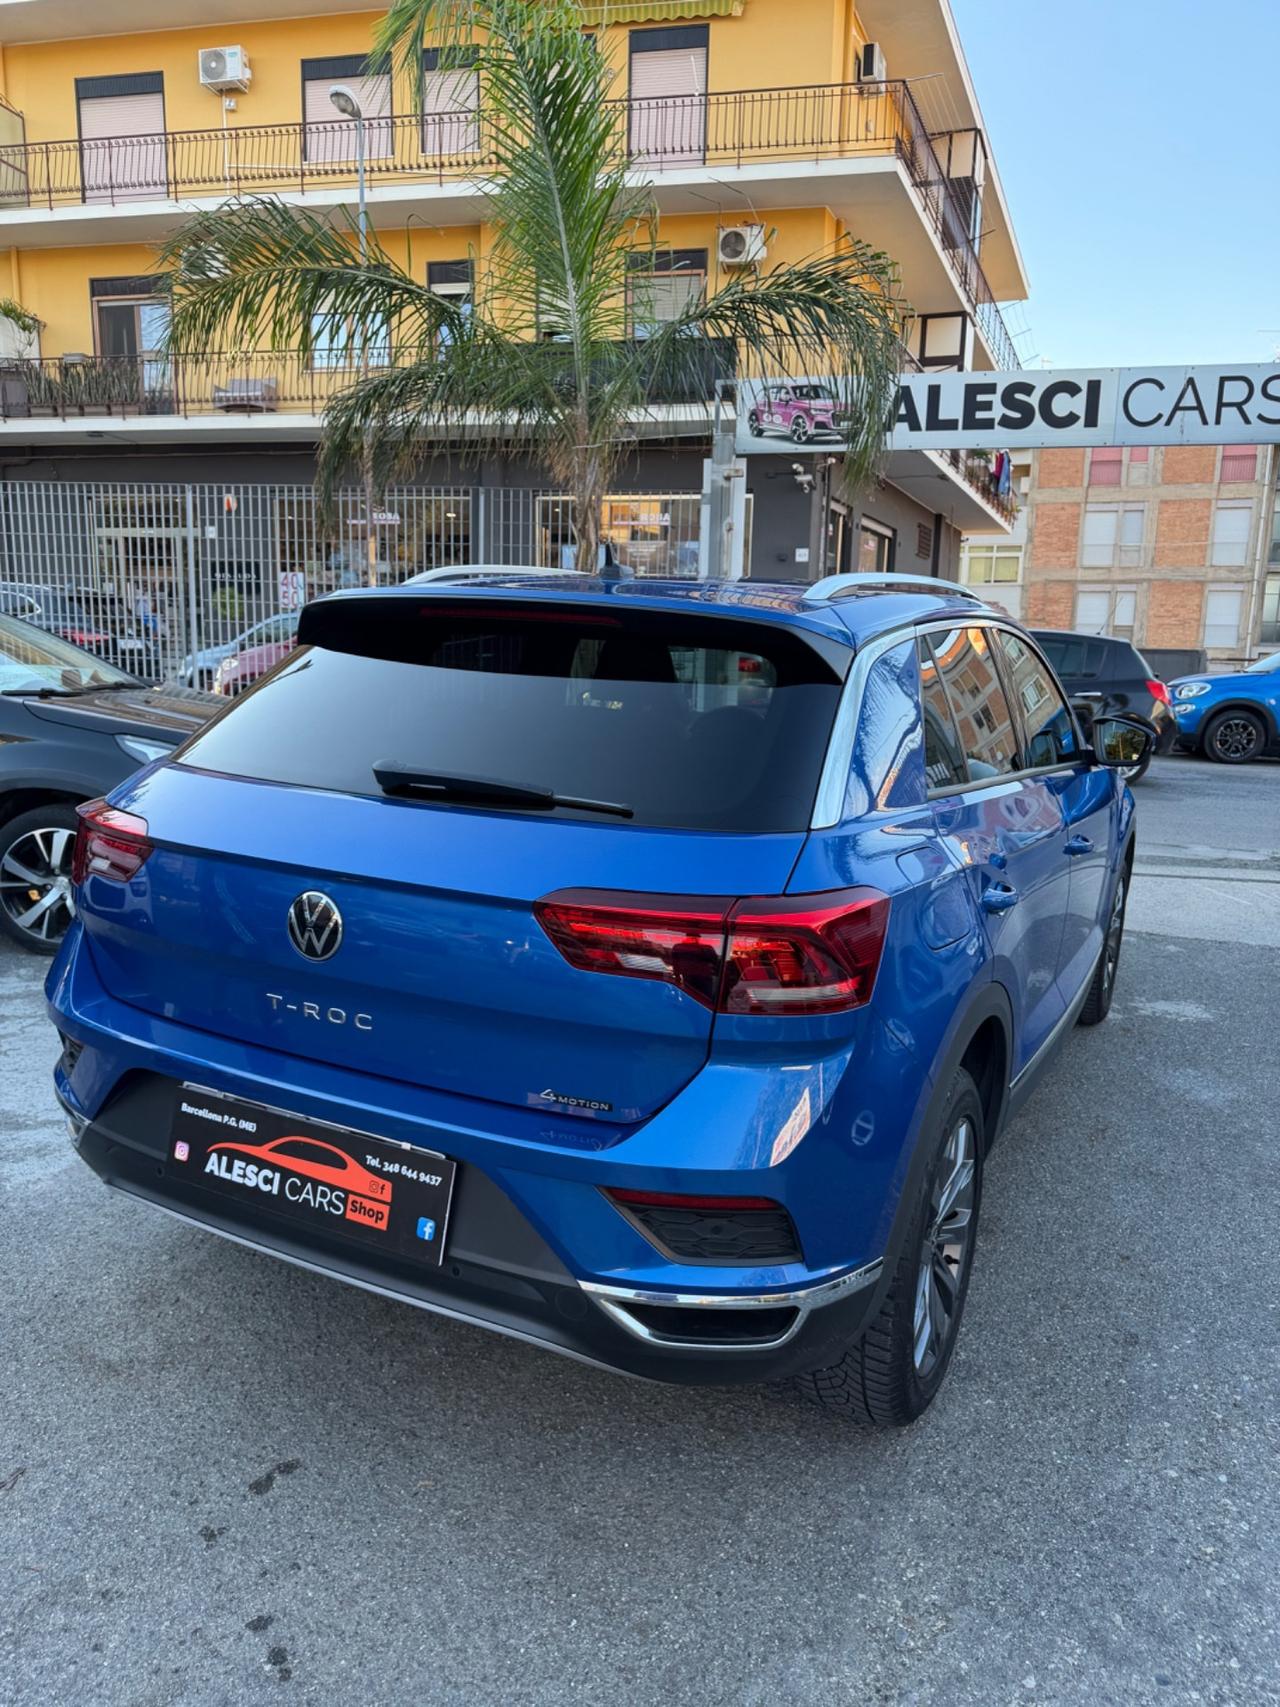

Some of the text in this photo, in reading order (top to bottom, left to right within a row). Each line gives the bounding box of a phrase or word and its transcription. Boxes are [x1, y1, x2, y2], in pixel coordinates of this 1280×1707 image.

[885, 379, 1102, 432] ALESCI
[266, 993, 372, 1030] T-ROC
[181, 1102, 223, 1123] Barcellona
[540, 1088, 610, 1111] 4MOTION
[204, 1152, 346, 1216] ALESCI CARS
[382, 1161, 401, 1174] 348
[401, 1165, 419, 1181] 644
[418, 1172, 442, 1187] 9437
[349, 1199, 384, 1224] Shop
